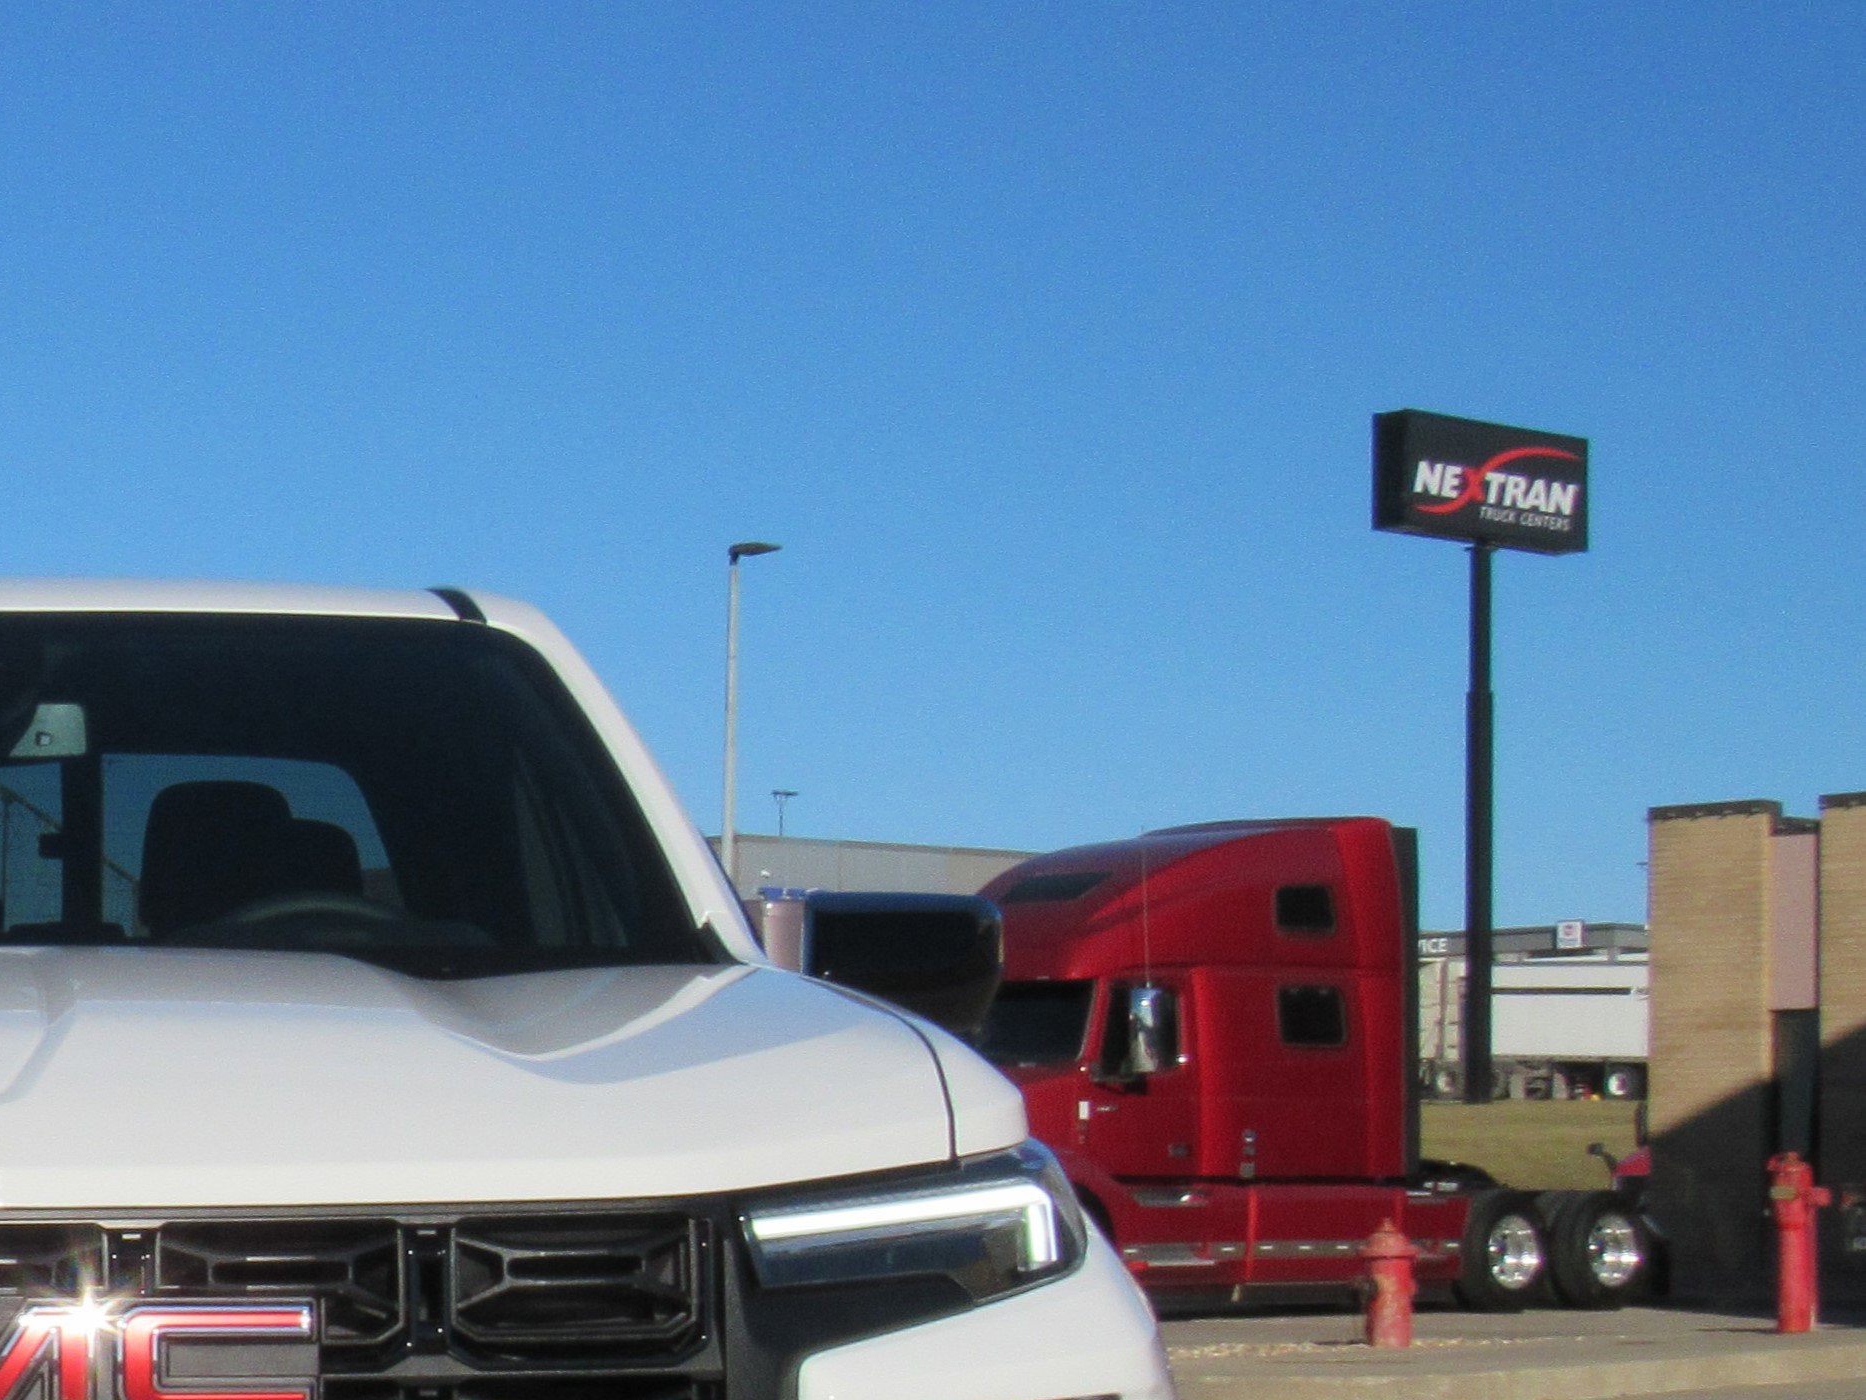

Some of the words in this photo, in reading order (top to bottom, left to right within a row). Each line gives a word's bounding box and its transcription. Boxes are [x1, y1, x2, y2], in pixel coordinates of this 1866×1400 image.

[1413, 459, 1578, 516] NEXTRAN
[1479, 506, 1517, 524] TRUCK
[1520, 511, 1572, 531] CENTERS
